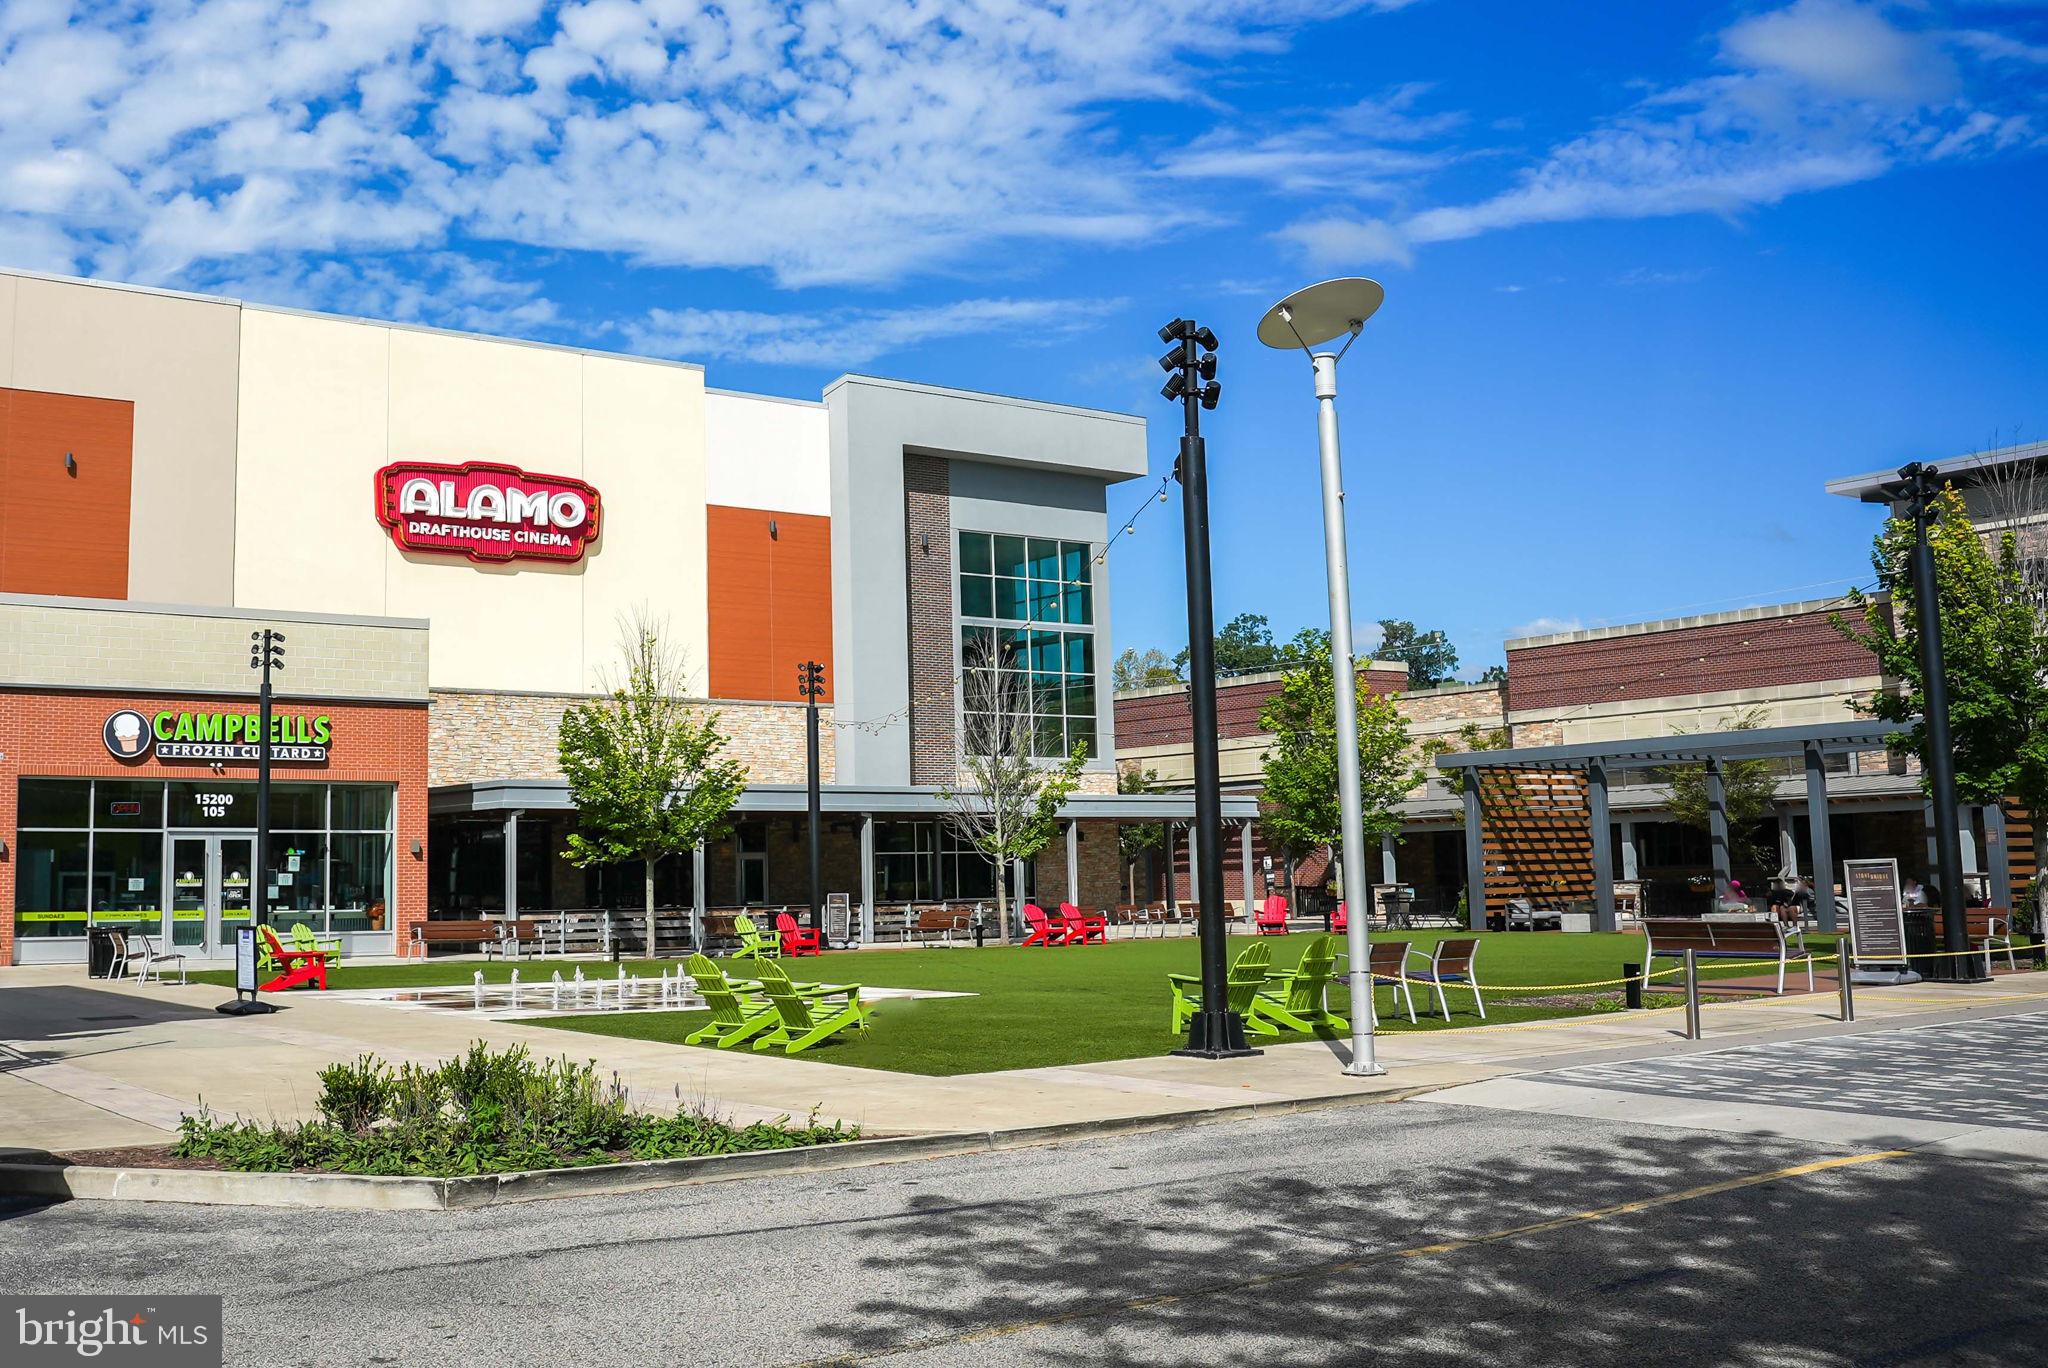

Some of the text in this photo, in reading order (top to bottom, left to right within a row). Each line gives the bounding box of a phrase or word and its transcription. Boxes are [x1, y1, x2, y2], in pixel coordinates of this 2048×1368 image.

[399, 477, 586, 529] ALAMO
[408, 521, 572, 547] DRAFTHOUSE CINEMA
[153, 710, 331, 744] CAMPBELLS
[172, 745, 311, 759] FROZEN CUTARD
[194, 793, 234, 805] 15200
[202, 806, 225, 817] 105
